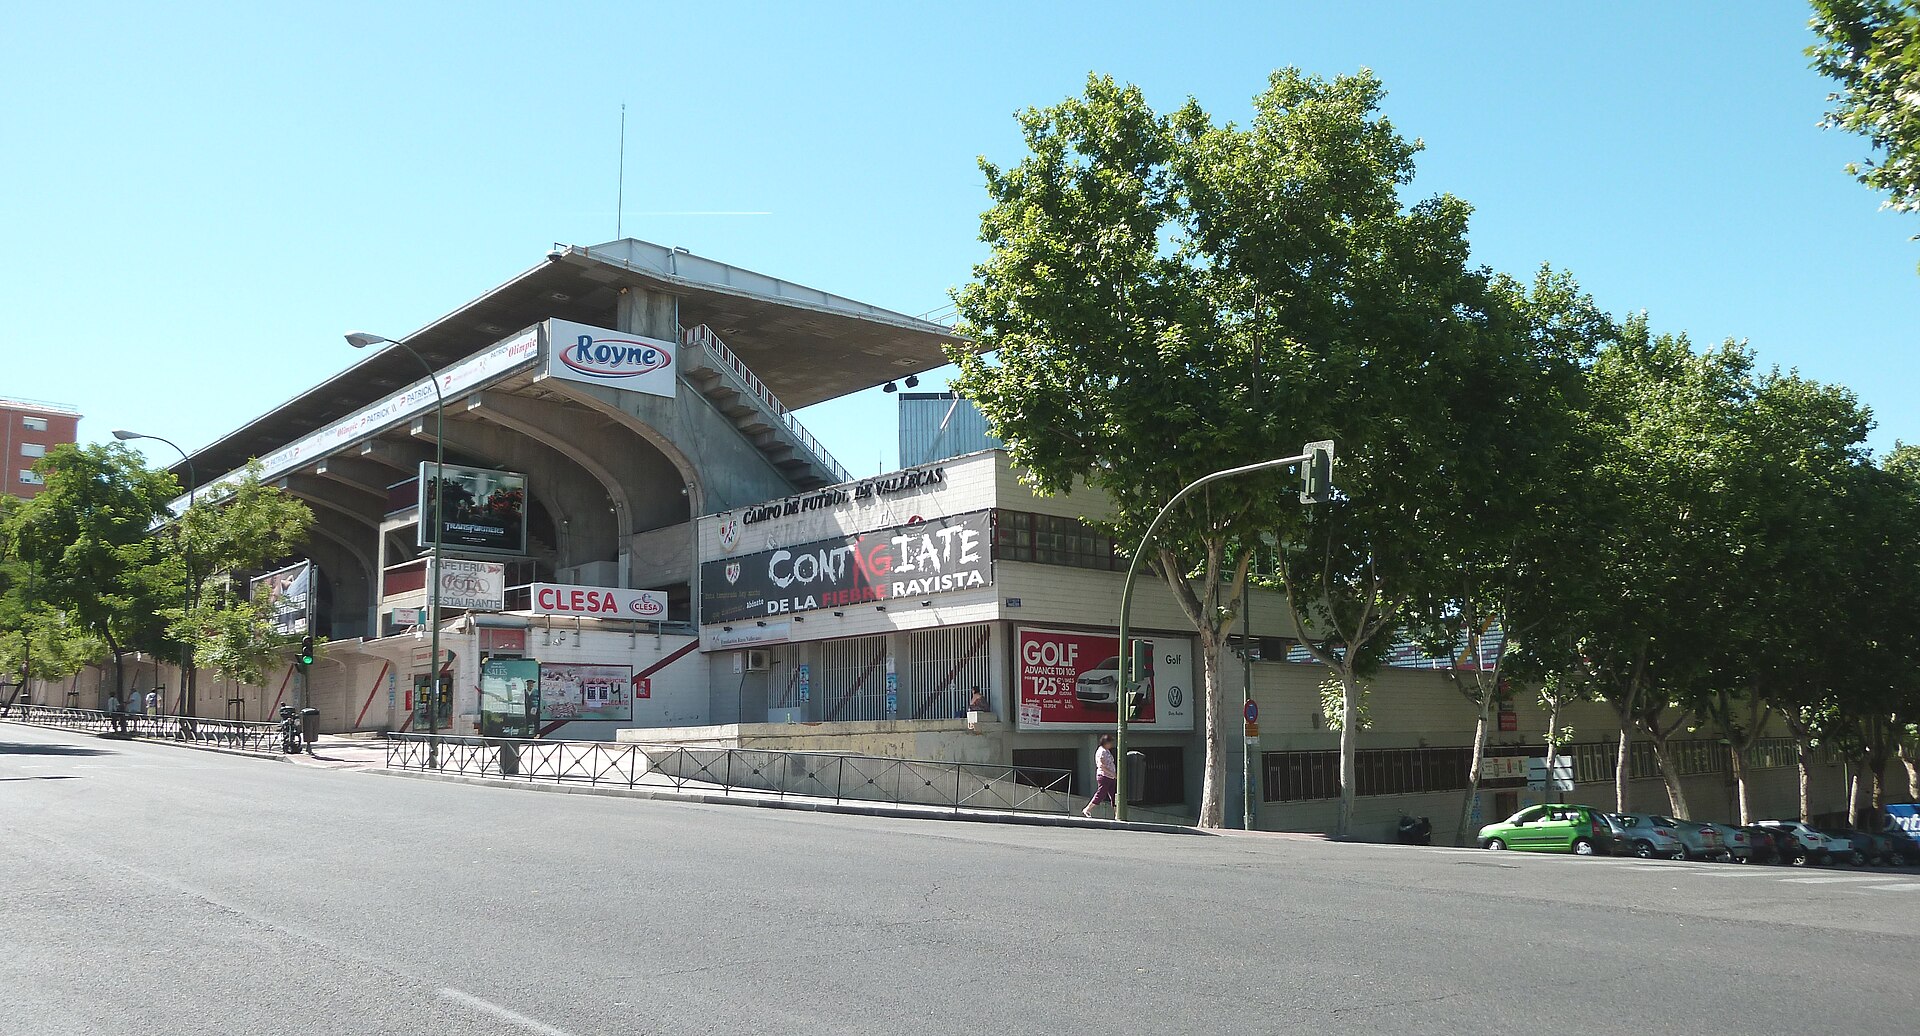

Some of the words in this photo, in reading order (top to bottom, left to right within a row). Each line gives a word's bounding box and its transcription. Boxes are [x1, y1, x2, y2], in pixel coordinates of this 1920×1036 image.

[508, 338, 537, 357] Olimpic
[576, 334, 657, 366] Royne
[406, 386, 432, 401] PATRICK
[366, 407, 390, 423] PATRICK
[743, 504, 781, 525] CAMPO
[783, 500, 799, 516] DE
[855, 483, 873, 500] DE
[875, 467, 944, 496] VALLECAS
[444, 522, 504, 534] TRANSFORMERS
[768, 521, 982, 589] CONTAGIATE
[538, 588, 618, 613] CLESA
[767, 597, 789, 614] DE
[794, 595, 817, 610] LA
[822, 584, 888, 606] FIEBRE
[893, 570, 984, 597] RAYISTA
[634, 603, 658, 611] CLESA
[1023, 640, 1079, 667] GOLF
[1166, 655, 1181, 665] Golf
[1025, 665, 1055, 675] ADVANCE
[1056, 667, 1065, 675] TDI
[1066, 668, 1076, 676] 105
[1032, 676, 1057, 695] 125
[1061, 683, 1069, 691] 35
